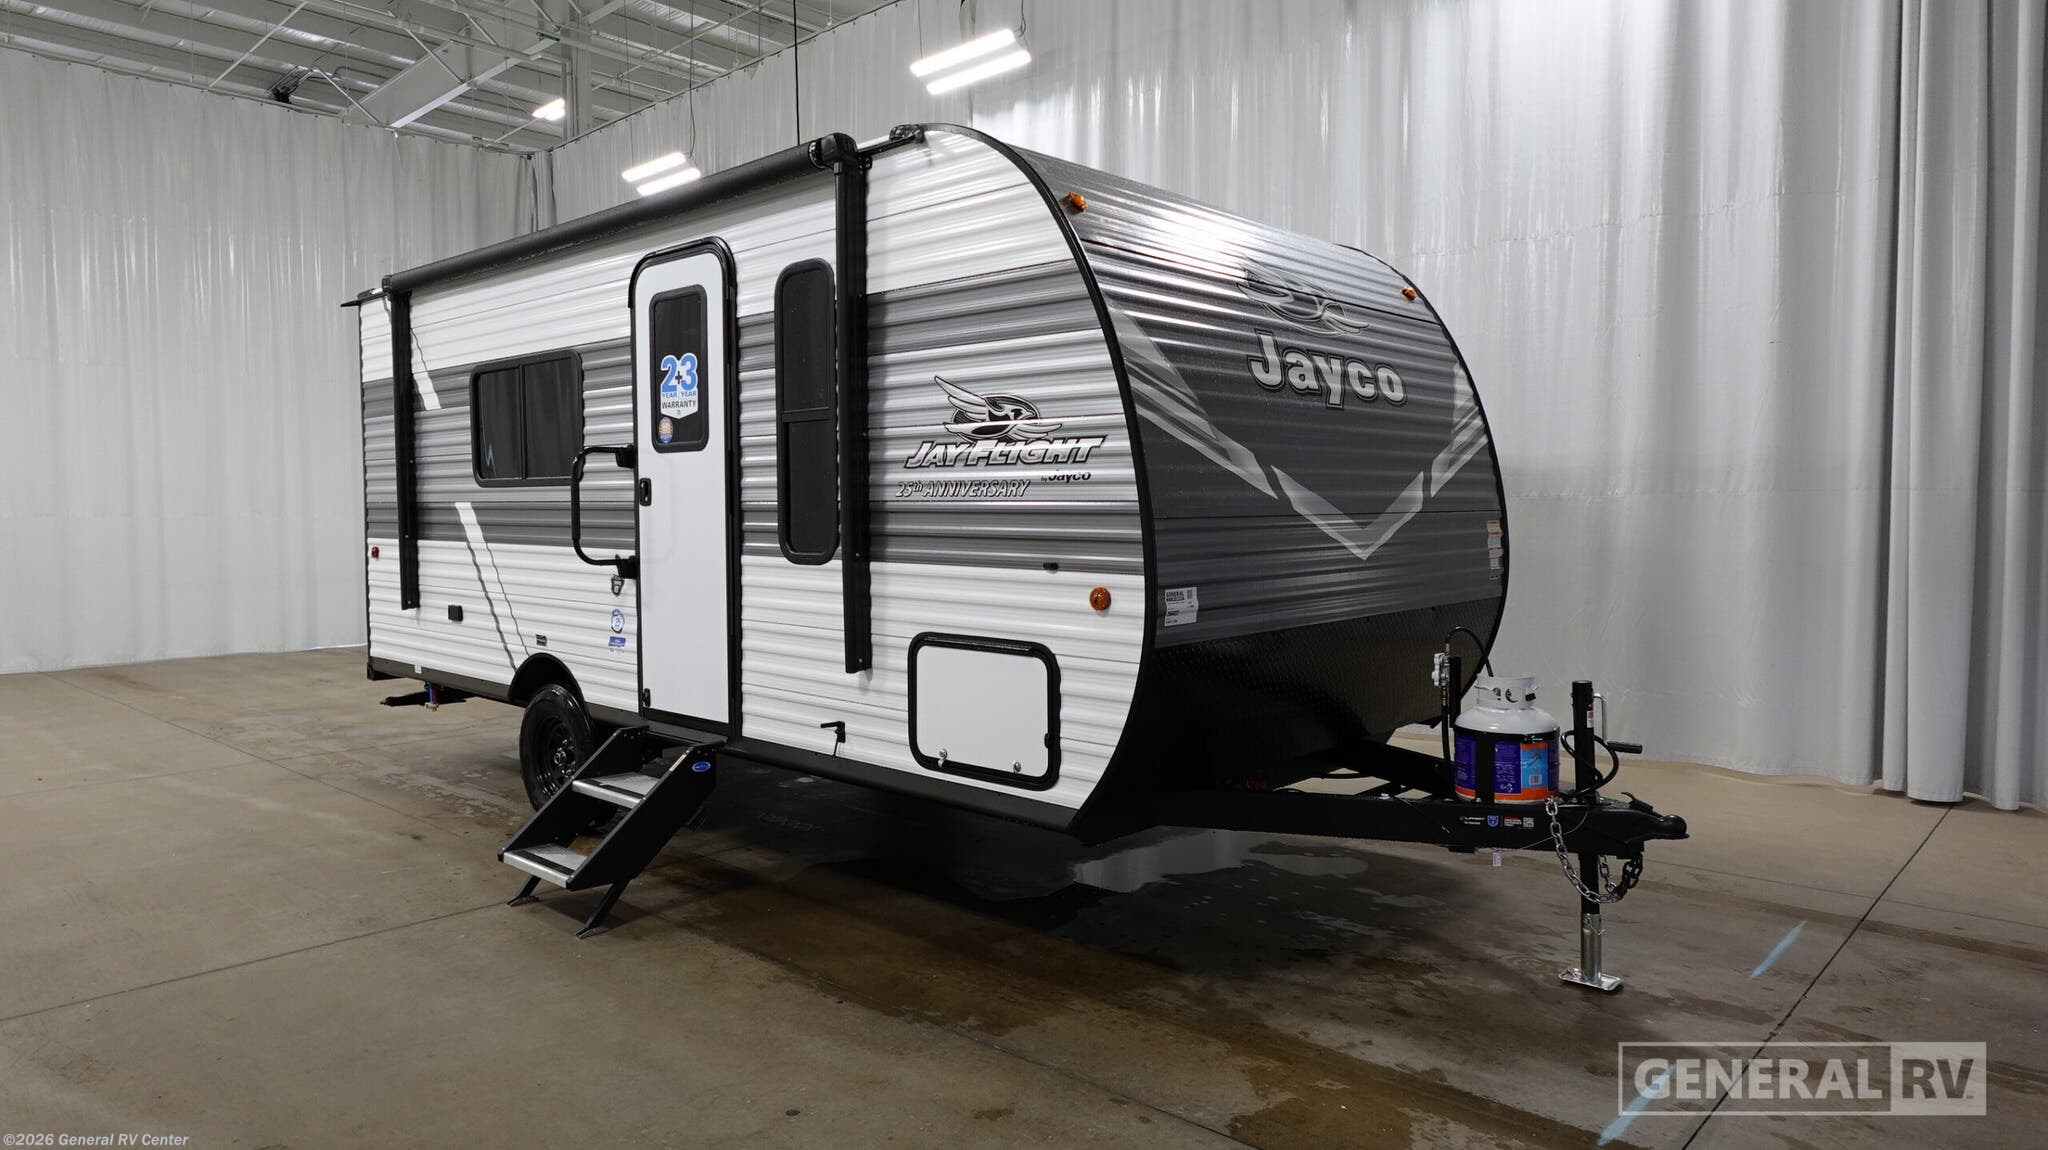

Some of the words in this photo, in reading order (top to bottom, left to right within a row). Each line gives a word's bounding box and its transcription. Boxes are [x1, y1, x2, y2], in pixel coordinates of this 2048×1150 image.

[1247, 328, 1407, 410] Jayco
[662, 391, 677, 399] YEAR
[681, 390, 697, 398] YEAR
[662, 399, 697, 409] WARRANTY
[923, 479, 1031, 498] ANNIVERSARY
